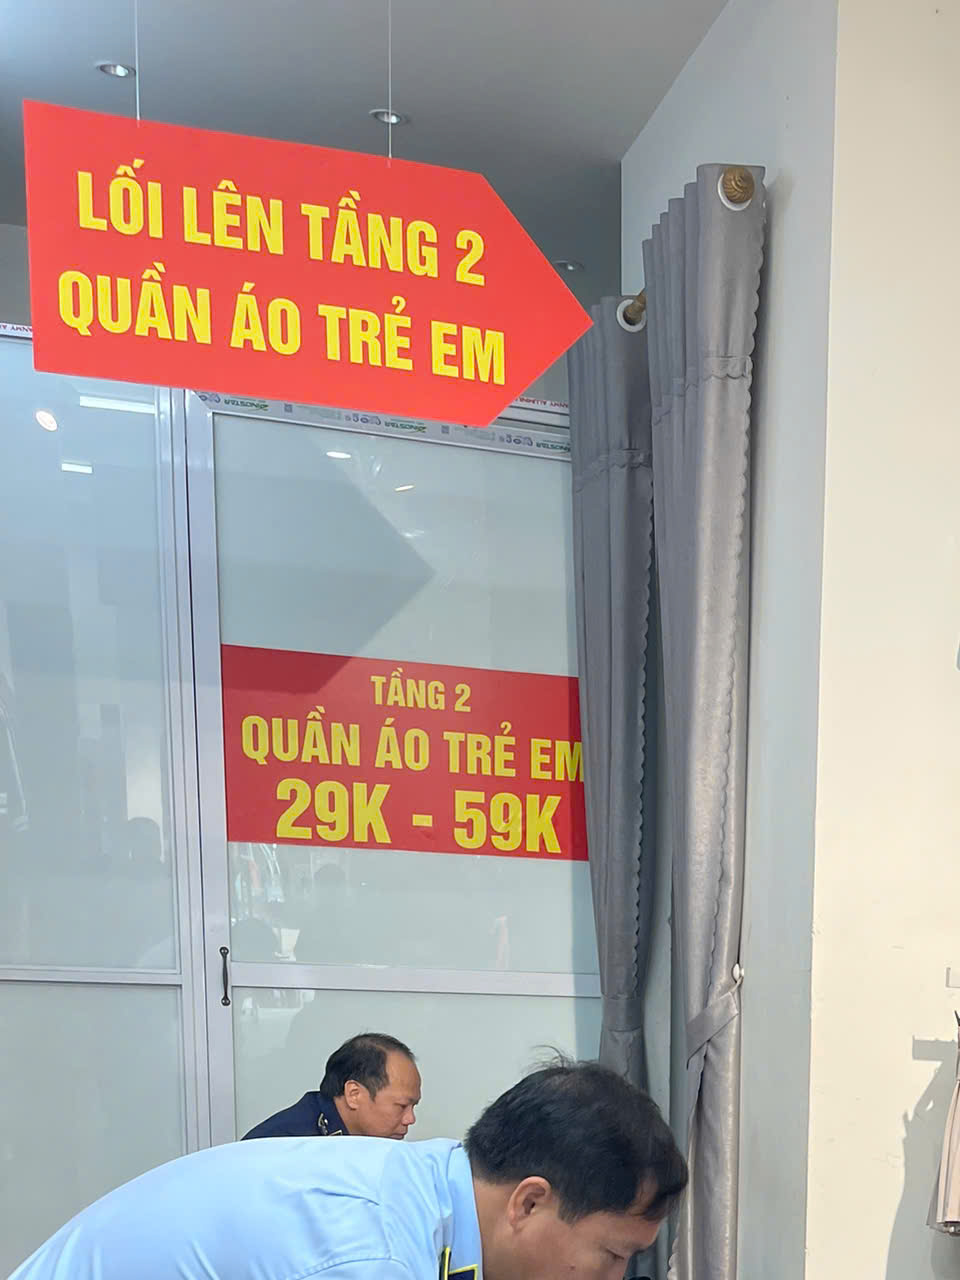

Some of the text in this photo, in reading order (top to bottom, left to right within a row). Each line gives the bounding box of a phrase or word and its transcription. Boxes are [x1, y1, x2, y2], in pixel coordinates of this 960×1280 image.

[77, 158, 486, 287] LỐI LÊN TẦNG 2
[58, 262, 506, 386] QUẦN ÁO TRẺ EM
[370, 667, 472, 713] TẦNG 2
[241, 705, 585, 783] QUẦN ÁO TRẺ EM
[276, 777, 562, 854] 29K - 59K
